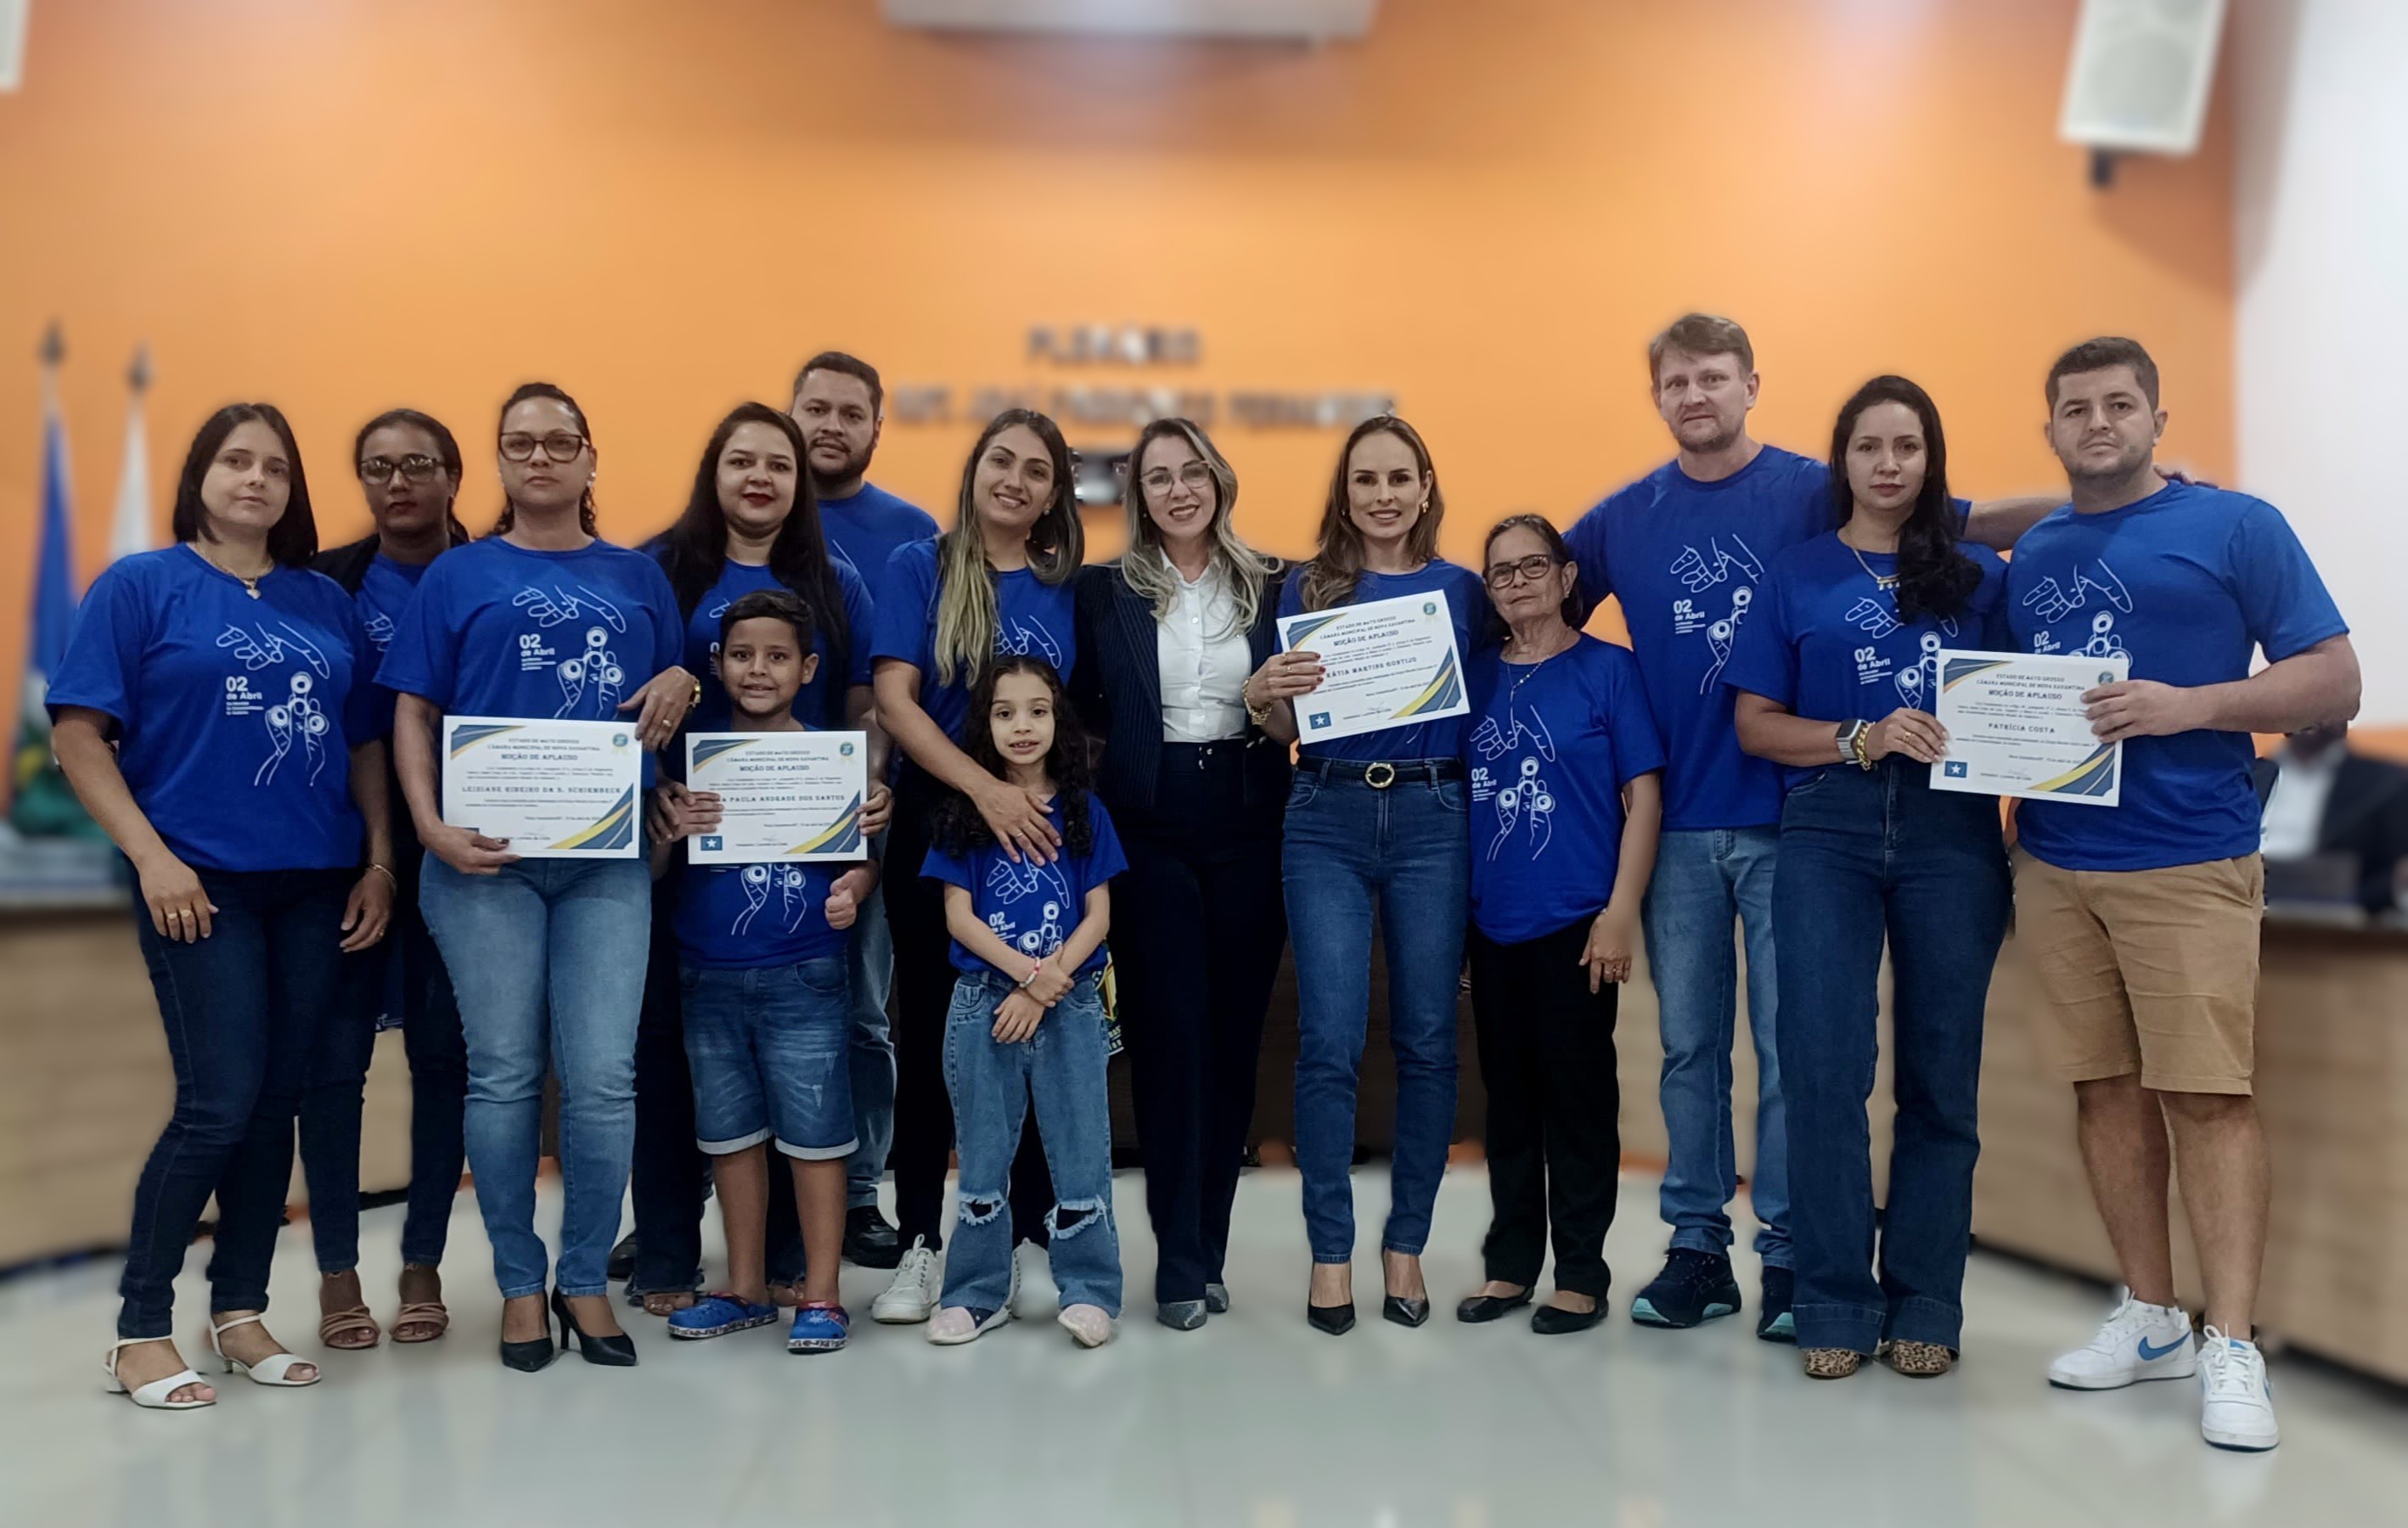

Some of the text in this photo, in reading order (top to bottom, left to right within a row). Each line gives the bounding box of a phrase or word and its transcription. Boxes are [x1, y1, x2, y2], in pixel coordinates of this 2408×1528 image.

[1674, 598, 1692, 614] 02
[520, 633, 541, 649] 02
[2034, 631, 2050, 648] 02
[1854, 646, 1876, 662] 02
[1870, 658, 1890, 668] Abril
[226, 676, 248, 692] 02
[239, 692, 262, 700] Abril
[2028, 692, 2062, 700] APLAUSO
[1988, 722, 2025, 732] PATRÍCIA
[1471, 767, 1488, 781] 02
[989, 912, 1005, 926] 02
